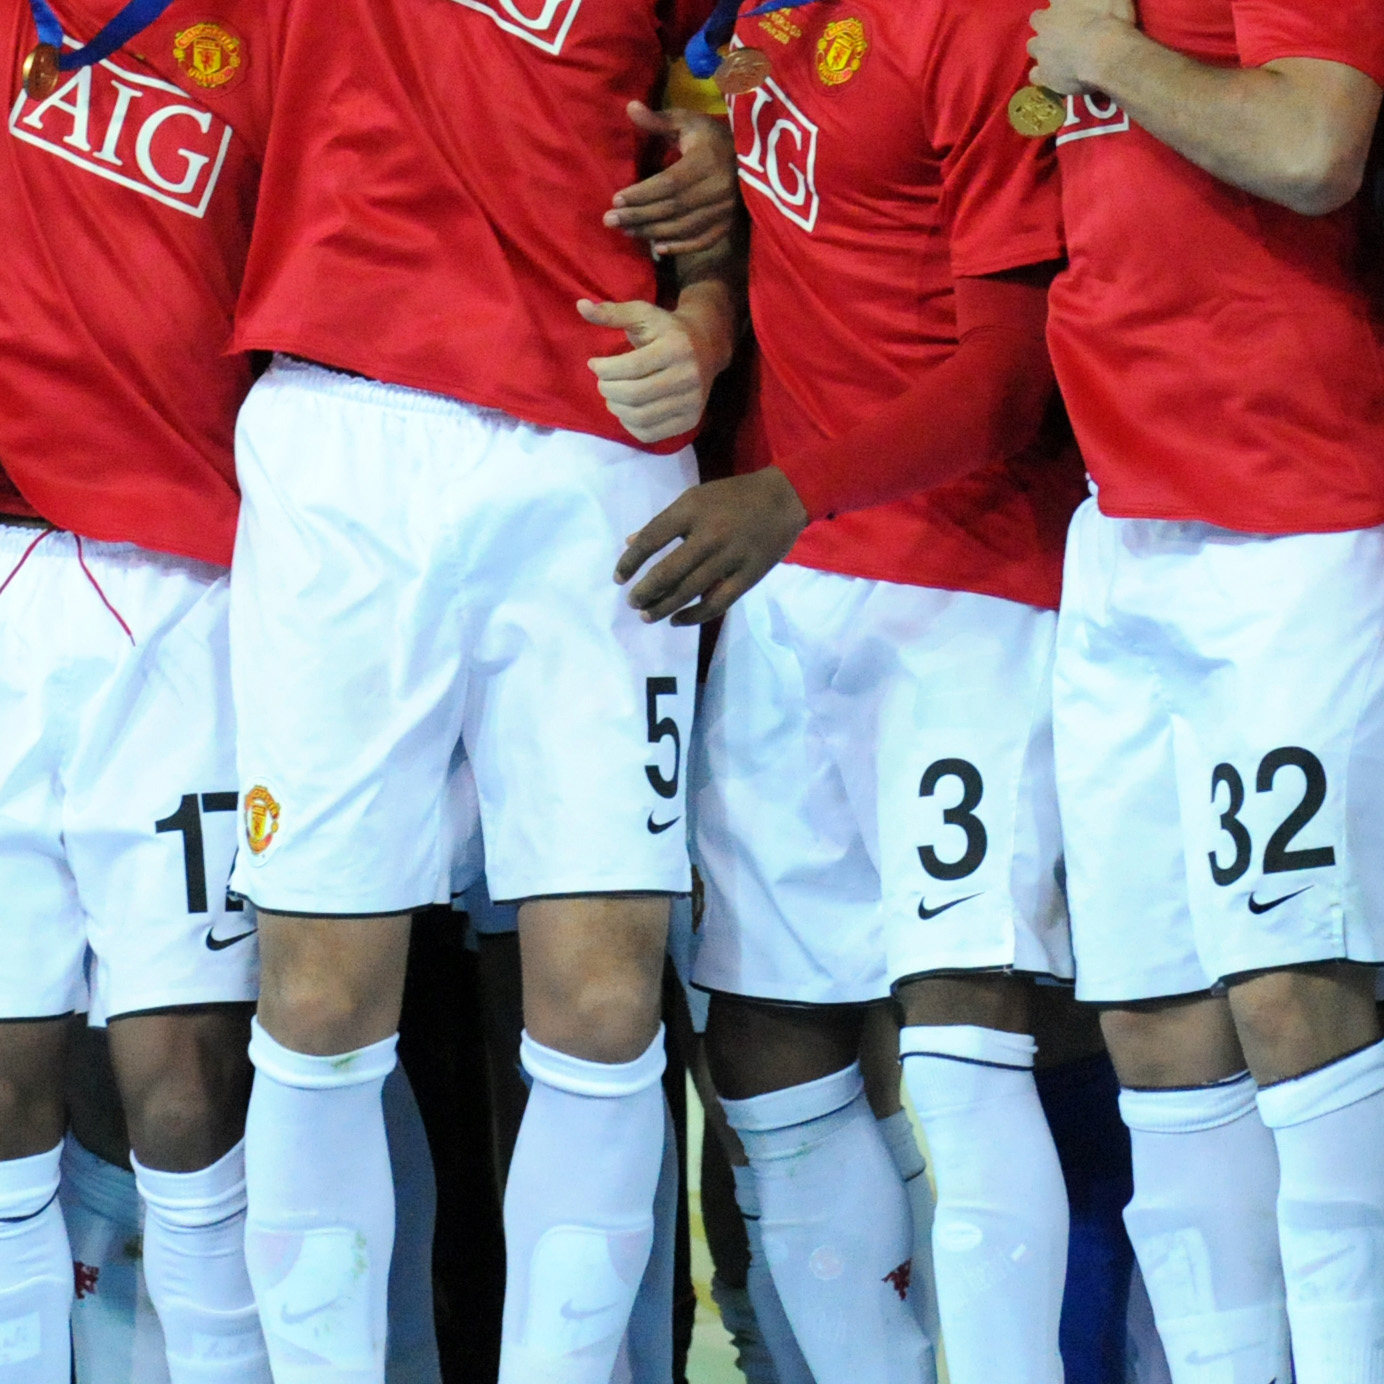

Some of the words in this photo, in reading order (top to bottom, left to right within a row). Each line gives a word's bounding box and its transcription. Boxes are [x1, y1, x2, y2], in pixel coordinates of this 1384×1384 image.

[22, 65, 213, 194] AIG
[729, 87, 806, 206] IG
[644, 676, 681, 799] 5
[917, 757, 988, 881] 3
[1208, 746, 1336, 887] 32
